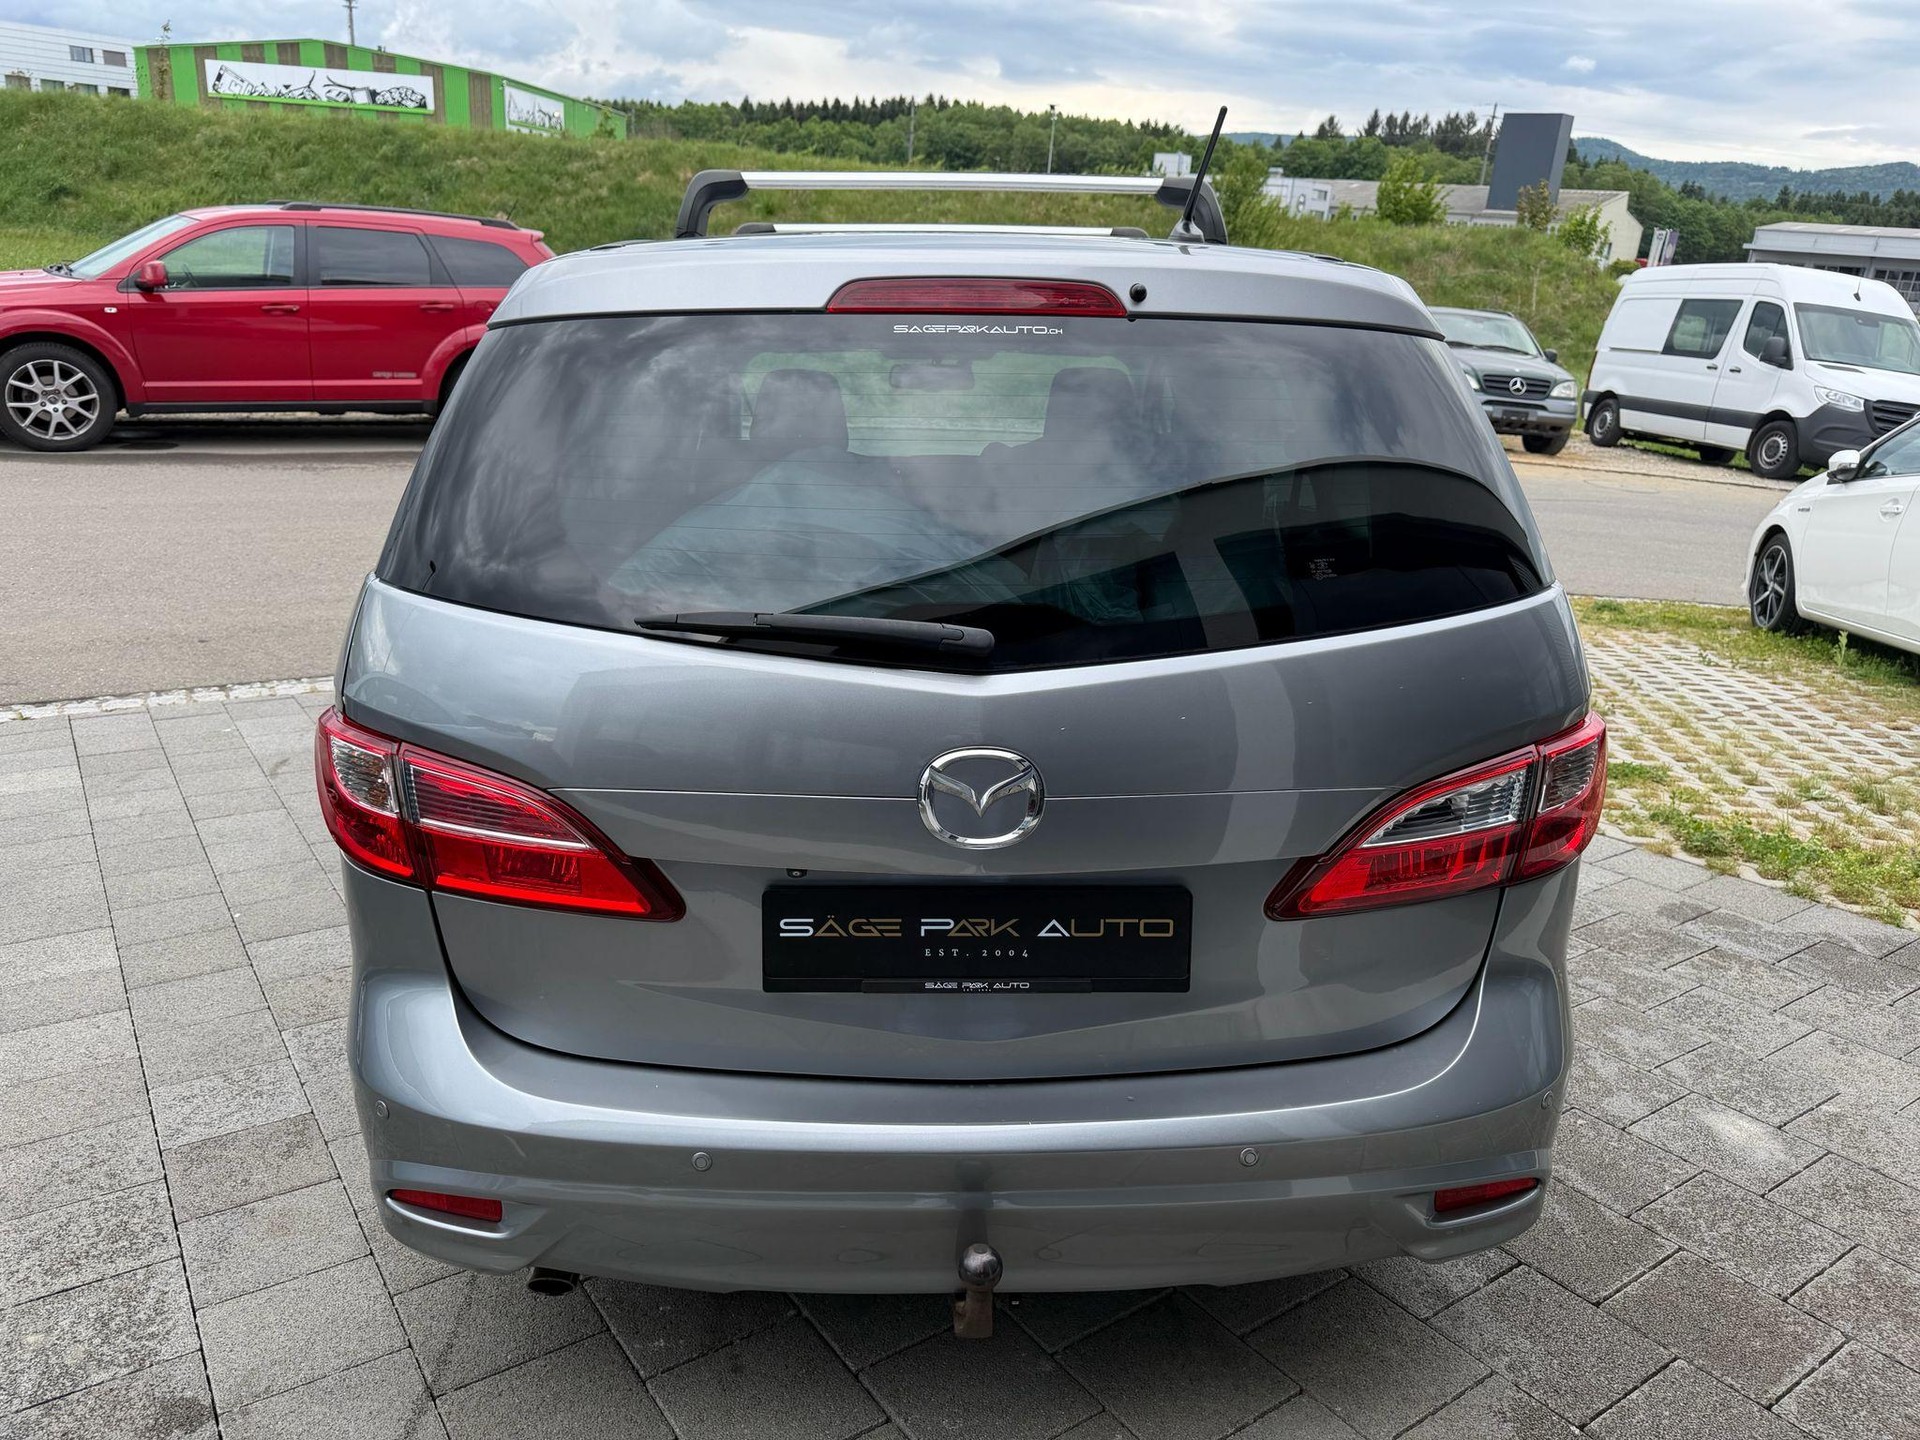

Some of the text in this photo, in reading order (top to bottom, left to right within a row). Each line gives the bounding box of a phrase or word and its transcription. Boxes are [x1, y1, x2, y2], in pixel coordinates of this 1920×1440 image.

[779, 915, 1175, 938] SÄGE PARK AUTO
[925, 948, 1030, 958] EST. 2004
[962, 981, 989, 989] PARK
[993, 981, 1030, 989] AUTO
